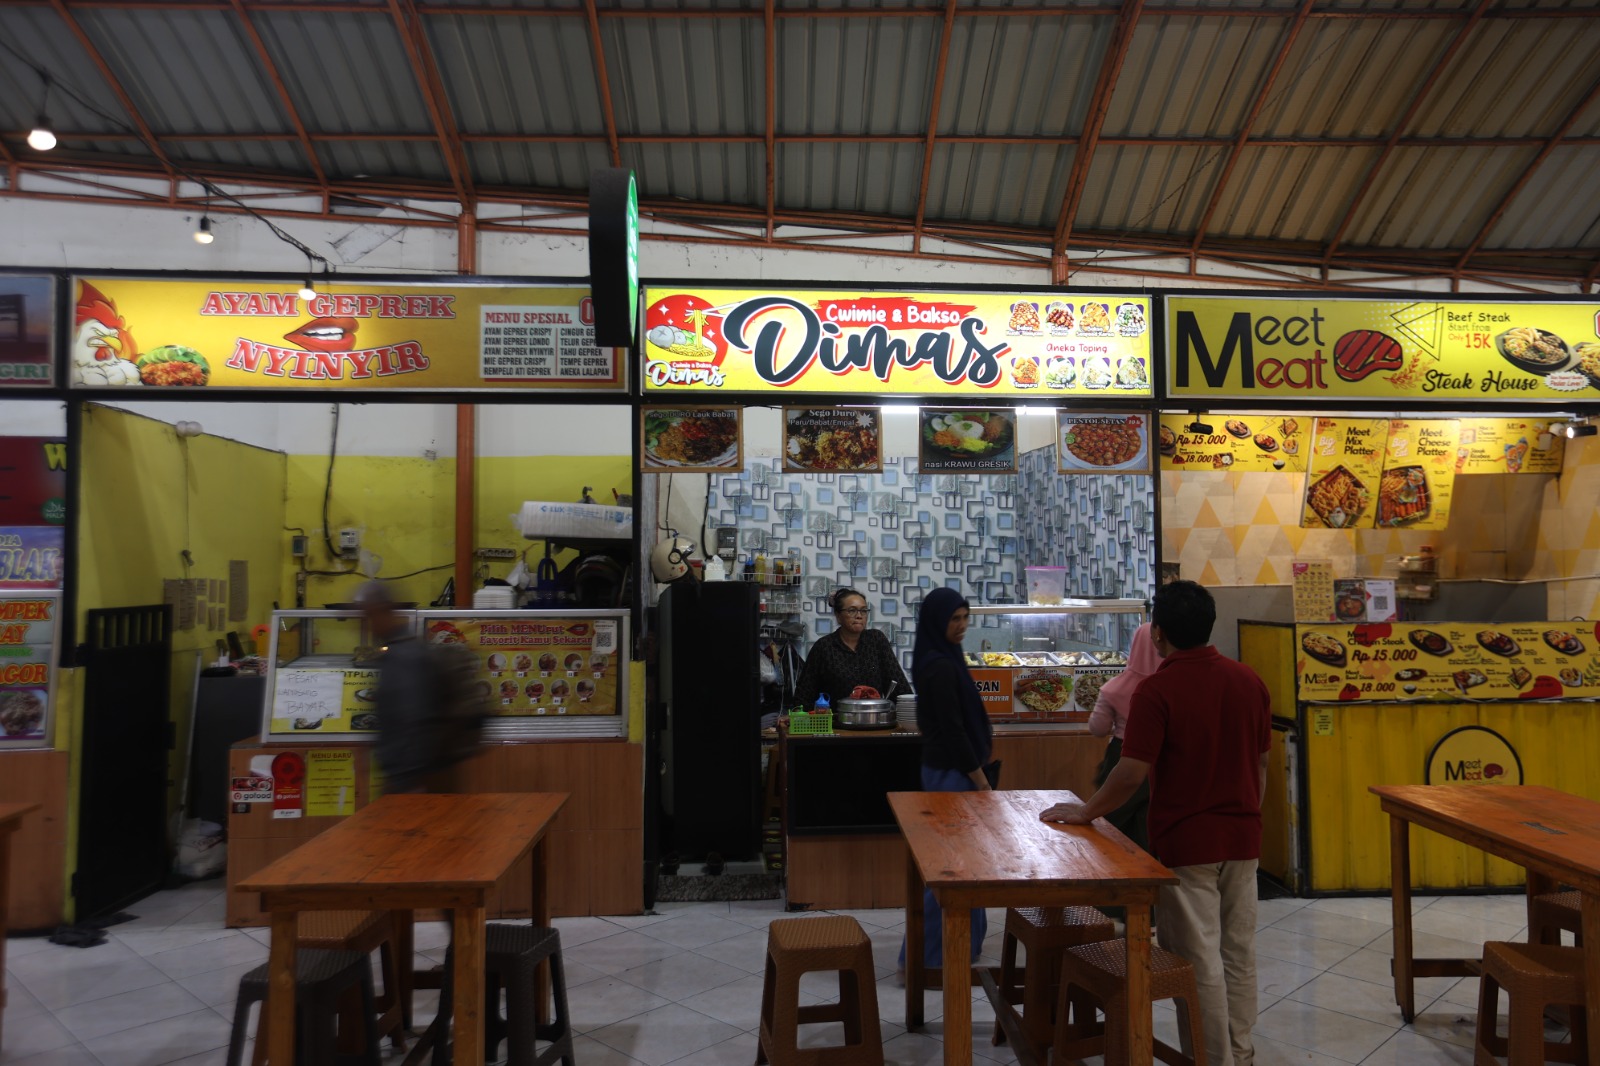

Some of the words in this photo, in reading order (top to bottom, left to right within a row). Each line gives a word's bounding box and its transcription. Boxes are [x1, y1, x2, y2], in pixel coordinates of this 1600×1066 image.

[201, 291, 299, 317] AYAM
[308, 293, 456, 319] GEPREK
[485, 313, 520, 323] MENU
[524, 313, 572, 324] SPESIAL
[826, 303, 887, 323] Cwimie
[892, 308, 902, 323] &
[907, 305, 960, 324] Bakso
[1447, 312, 1472, 323] Beef
[1478, 312, 1511, 323] Steak
[484, 327, 502, 336] AYAM
[503, 327, 528, 336] GEPREK
[529, 327, 552, 336] CRISPY
[484, 337, 502, 346] AYAM
[503, 337, 528, 346] GEPREK
[723, 297, 1008, 385] Dimas
[1464, 333, 1492, 348] 15K
[484, 347, 502, 356] AYAM
[503, 347, 528, 356] GEPREK
[561, 348, 577, 356] TAHU
[578, 348, 603, 357] GEPREK
[1079, 343, 1108, 354] Toping
[226, 337, 431, 380] NYINYIR
[484, 357, 497, 366] MIE
[498, 357, 522, 366] GEPREK
[523, 357, 547, 366] CRISPY
[561, 358, 582, 366] TEMPE
[583, 358, 608, 367] GEPREK
[515, 367, 526, 376] ATI
[527, 367, 551, 376] GEPREK
[561, 368, 581, 376] ANEKA
[582, 368, 610, 376] LALAPAN
[645, 360, 726, 386] Dimas
[1422, 369, 1475, 392] Steak
[1481, 370, 1538, 392] House
[809, 409, 830, 418] Sego
[832, 409, 855, 417] Duro
[1347, 426, 1370, 436] Meet
[1419, 428, 1443, 437] Meet
[1176, 435, 1190, 446] Rp
[1191, 435, 1227, 445] 15.000
[1345, 436, 1363, 445] Mix
[1418, 437, 1451, 447] Cheese
[1344, 446, 1376, 455] Platter
[1416, 446, 1448, 456] Platter
[1185, 455, 1213, 463] 18.000
[480, 624, 508, 634] Pilih
[511, 624, 564, 634] MENUrut
[480, 635, 519, 645] Favorit
[520, 636, 550, 645] Kamu
[553, 636, 593, 645] Sekaran
[1382, 638, 1405, 646] Steak
[1352, 649, 1370, 663] Rp
[1372, 649, 1417, 661] 15.000
[0, 664, 49, 684] GOR
[974, 681, 999, 692] SAN
[1360, 683, 1395, 692] 18.000
[244, 792, 272, 801] gofood
